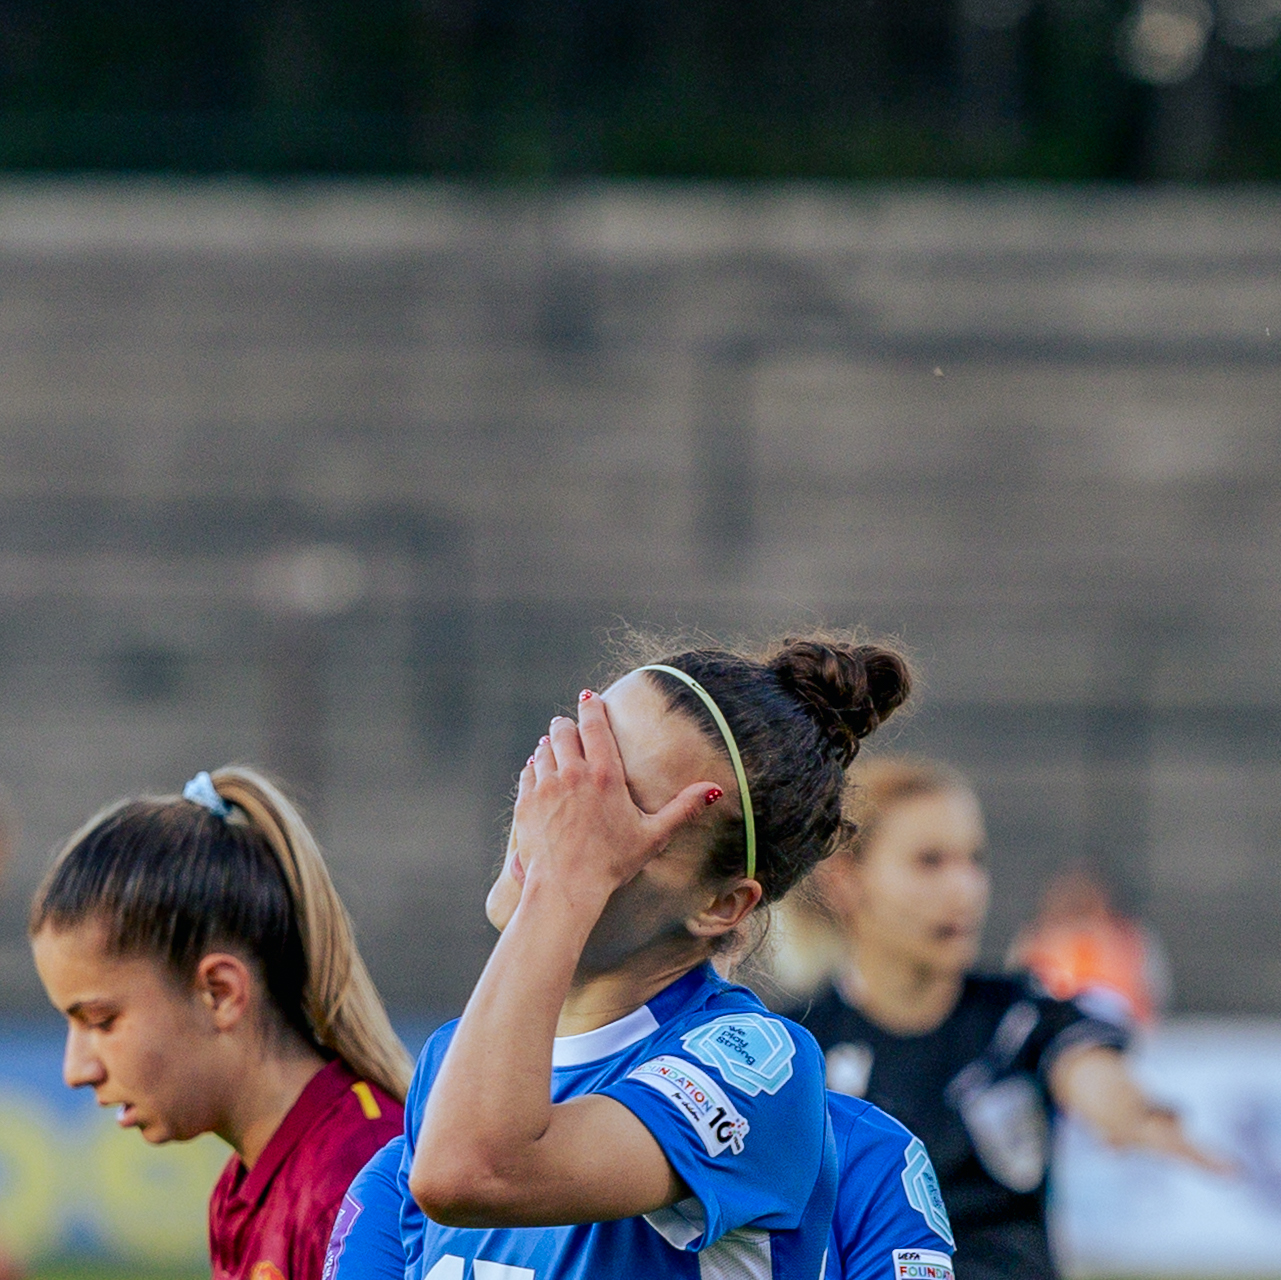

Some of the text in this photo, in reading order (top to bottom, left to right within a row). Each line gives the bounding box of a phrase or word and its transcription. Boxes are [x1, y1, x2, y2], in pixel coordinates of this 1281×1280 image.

[721, 1030, 749, 1048] play
[708, 1106, 737, 1144] 10
[897, 1251, 921, 1261] UEFA
